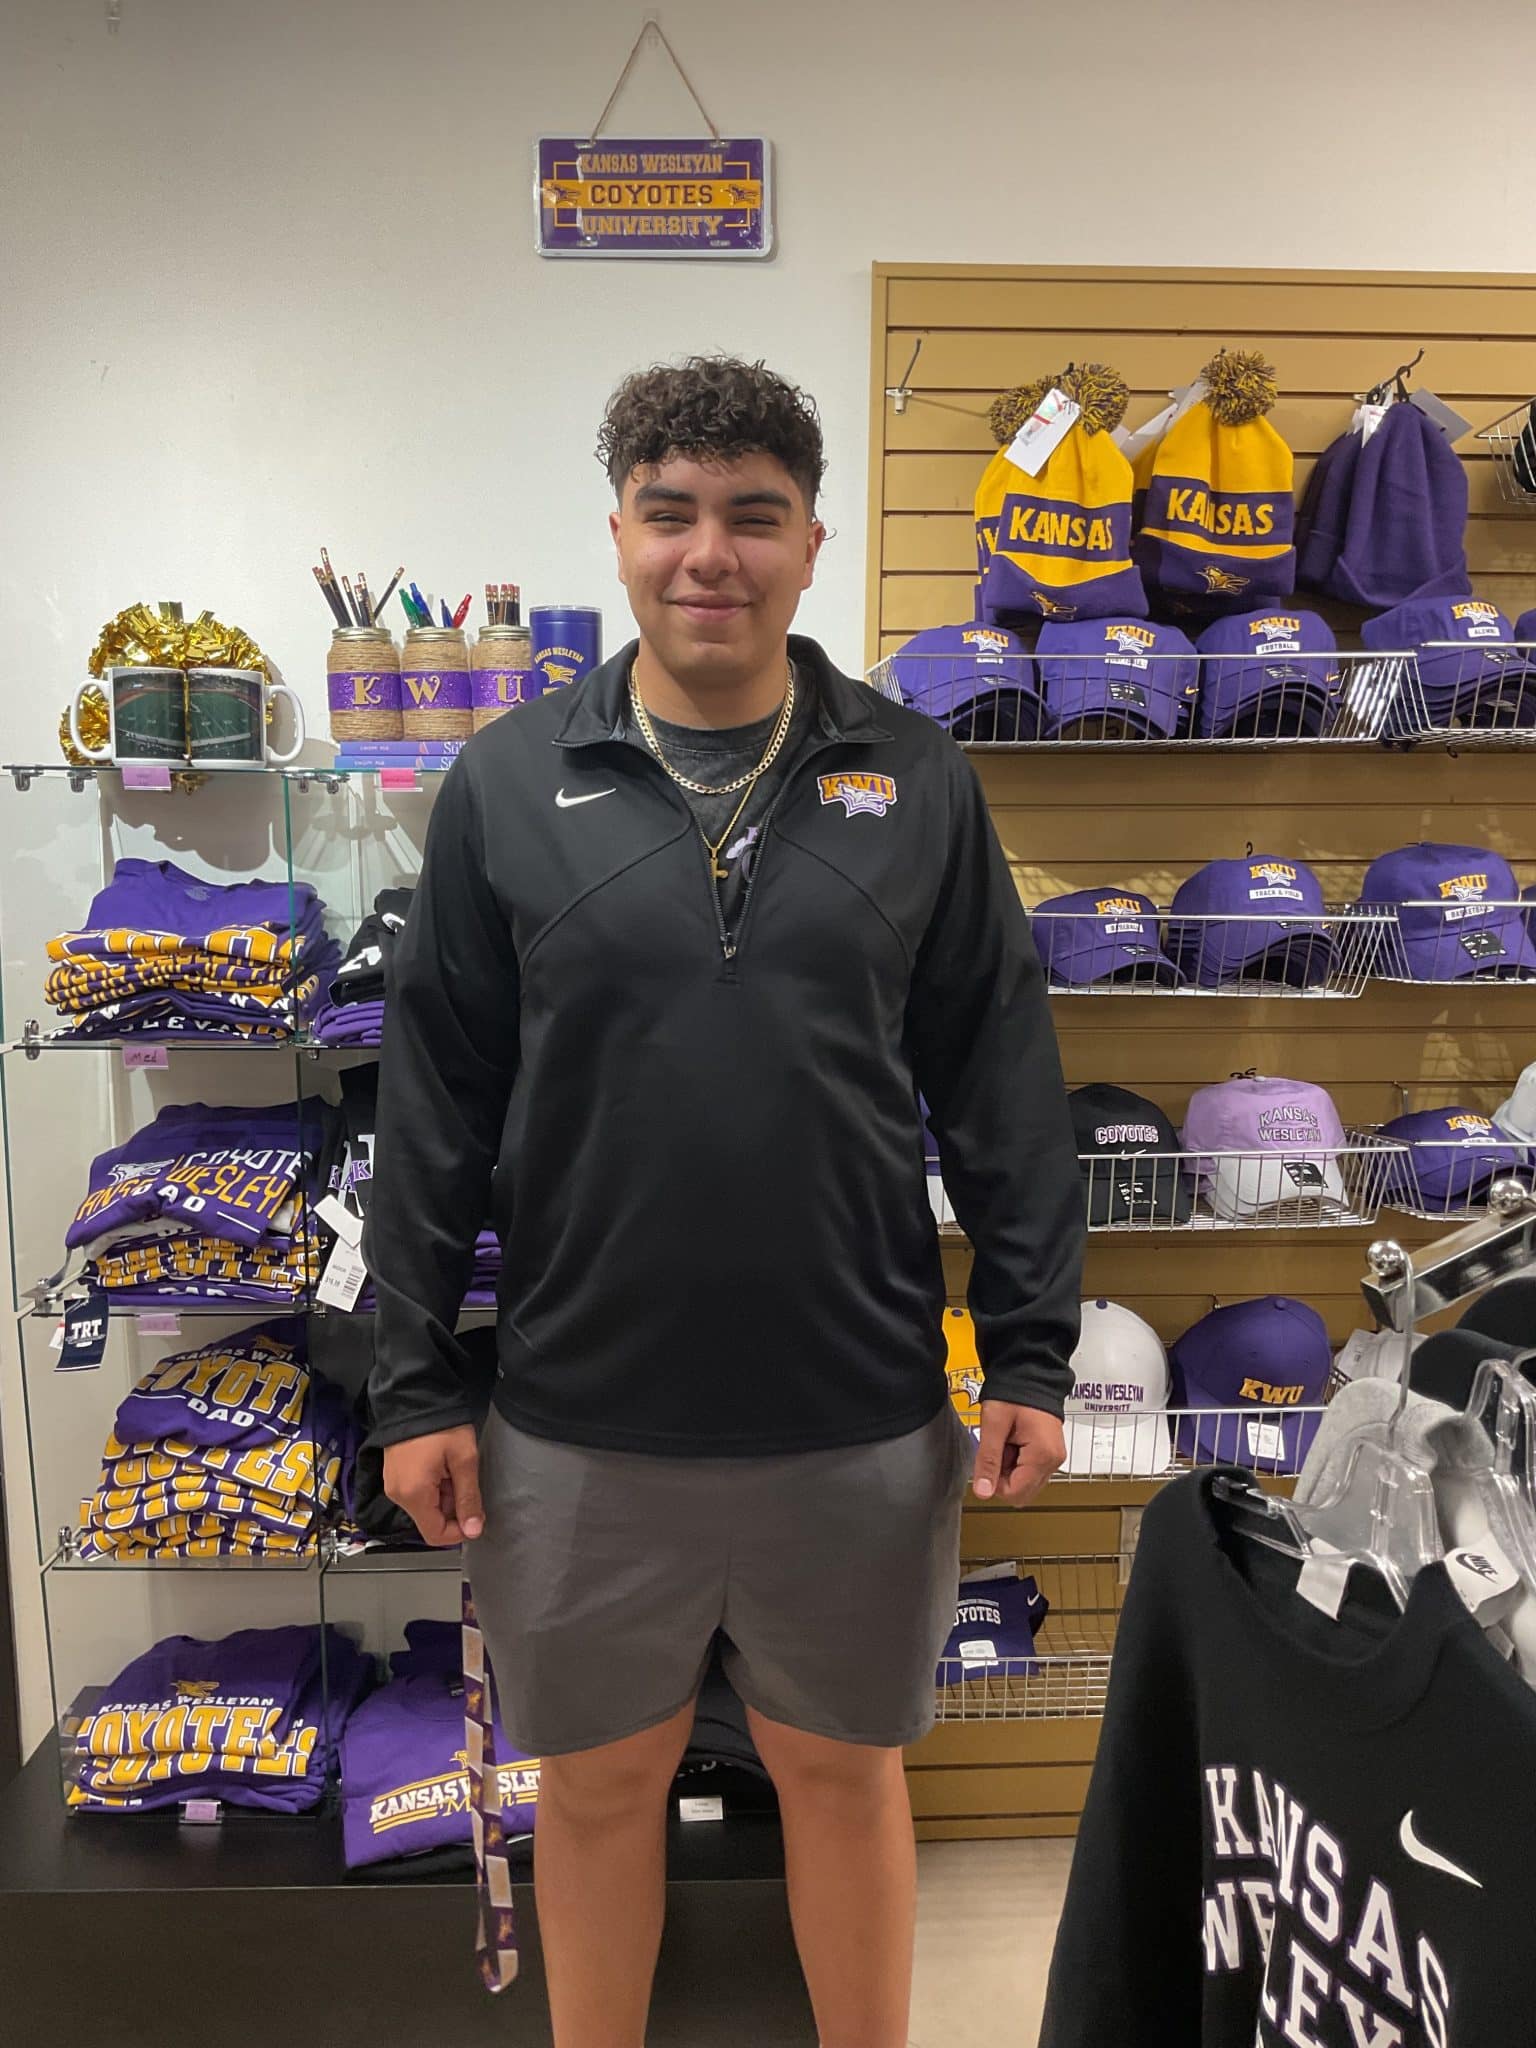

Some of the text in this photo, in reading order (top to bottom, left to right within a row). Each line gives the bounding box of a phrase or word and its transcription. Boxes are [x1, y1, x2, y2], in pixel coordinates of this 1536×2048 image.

[578, 154, 723, 174] KANSAS WESLEYAN
[590, 184, 713, 205] COYOTES
[581, 215, 723, 236] UNIVERSITY
[1451, 602, 1499, 619] KWU
[1249, 617, 1300, 635] KWU
[962, 630, 1009, 648] KWU
[1104, 625, 1155, 648] KWU
[350, 674, 526, 705] K W U
[821, 774, 894, 801] KWU
[1249, 863, 1297, 879] KWU
[1438, 874, 1488, 899] KWU
[1095, 898, 1142, 914] KWU
[1258, 1106, 1319, 1129] KANSAS
[1445, 1115, 1493, 1130] KWU
[1095, 1125, 1159, 1144] COYOTES
[1257, 1128, 1322, 1142] WESLEYAN
[71, 1319, 102, 1340] TRT
[1105, 1383, 1145, 1403] WESLEYAN
[1239, 1377, 1305, 1405] KWU
[187, 1397, 256, 1428] DAD
[1084, 1402, 1131, 1413] UNIVERSITY
[1467, 1555, 1499, 1575] NIKE
[98, 1695, 274, 1715] KANSAS WESLEYAN
[369, 1778, 454, 1824] KANSAS
